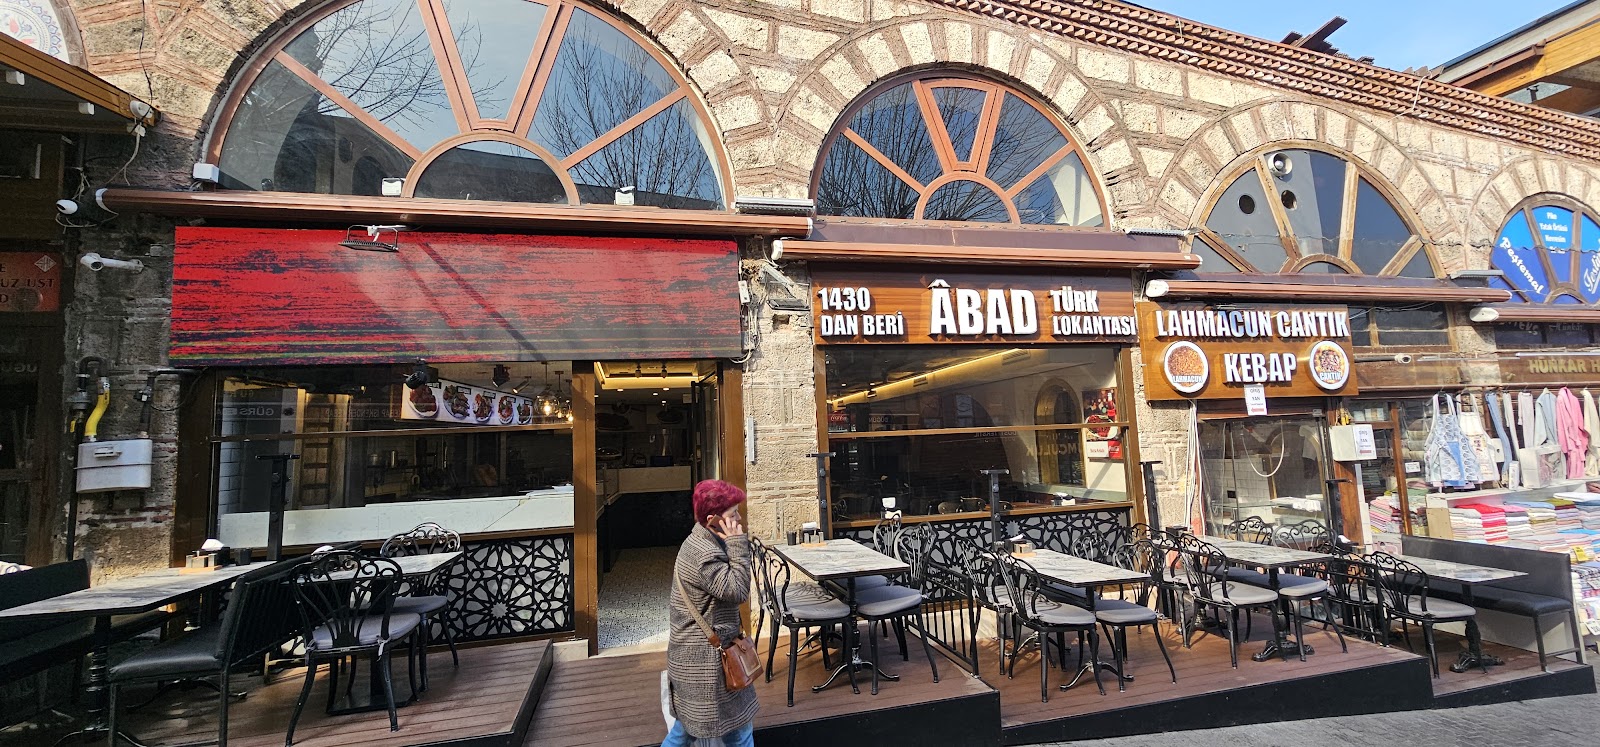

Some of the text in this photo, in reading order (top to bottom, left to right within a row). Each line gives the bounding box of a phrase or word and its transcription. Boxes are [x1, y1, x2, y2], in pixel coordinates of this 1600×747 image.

[818, 287, 871, 312] 1430
[929, 279, 1038, 335] ÂBAD
[1050, 286, 1100, 313] TÜRK
[820, 311, 904, 336] DAN BERİ
[1053, 315, 1137, 337] LOKANTASI
[1156, 310, 1350, 337] LAHMACUN CANTIK
[1223, 352, 1297, 383] KEBAP
[1529, 357, 1587, 374] HÜNKAR
